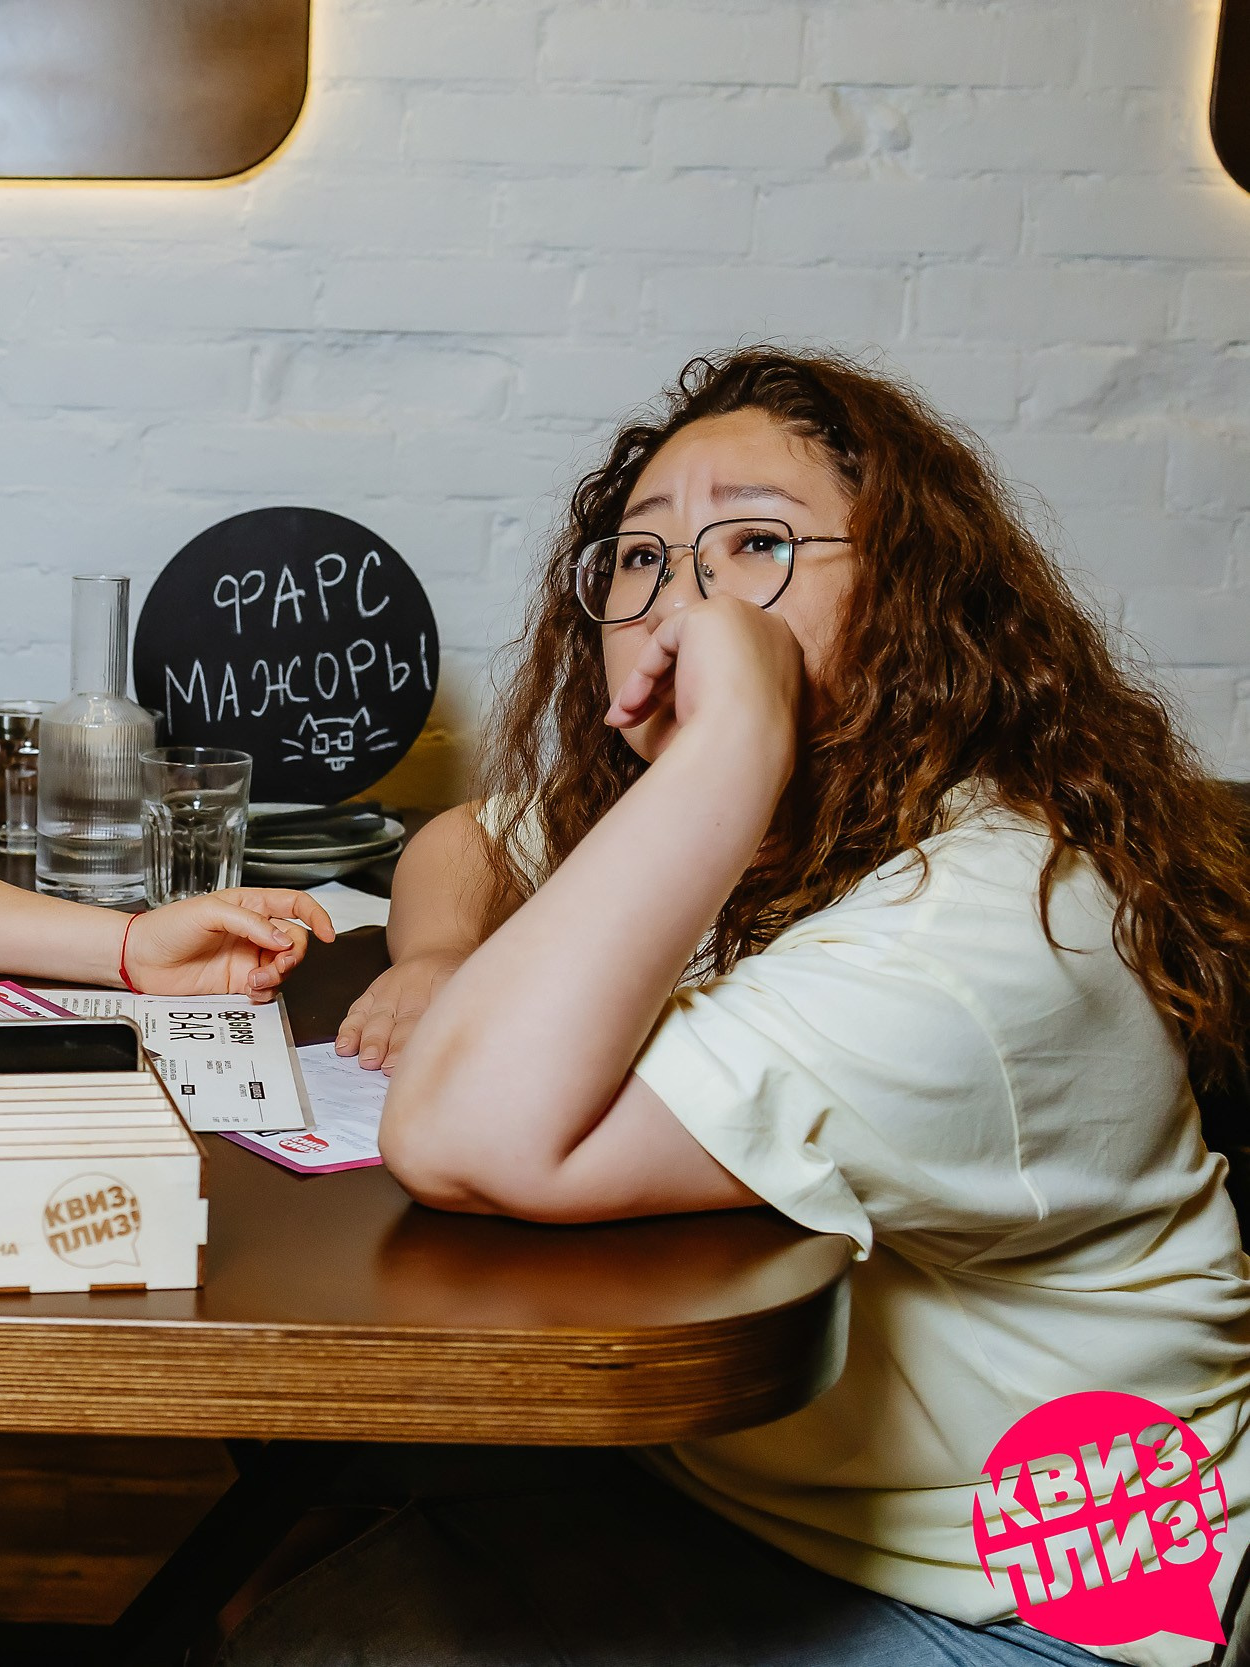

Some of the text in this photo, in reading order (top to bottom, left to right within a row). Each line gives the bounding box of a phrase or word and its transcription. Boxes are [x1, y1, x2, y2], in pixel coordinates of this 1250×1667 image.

[213, 551, 390, 634] ФАРС
[165, 632, 432, 735] МАЖОРЫ
[168, 1012, 215, 1041] BAR
[228, 1021, 255, 1045] GIPSY
[48, 1210, 141, 1255] ПЛИЗ!
